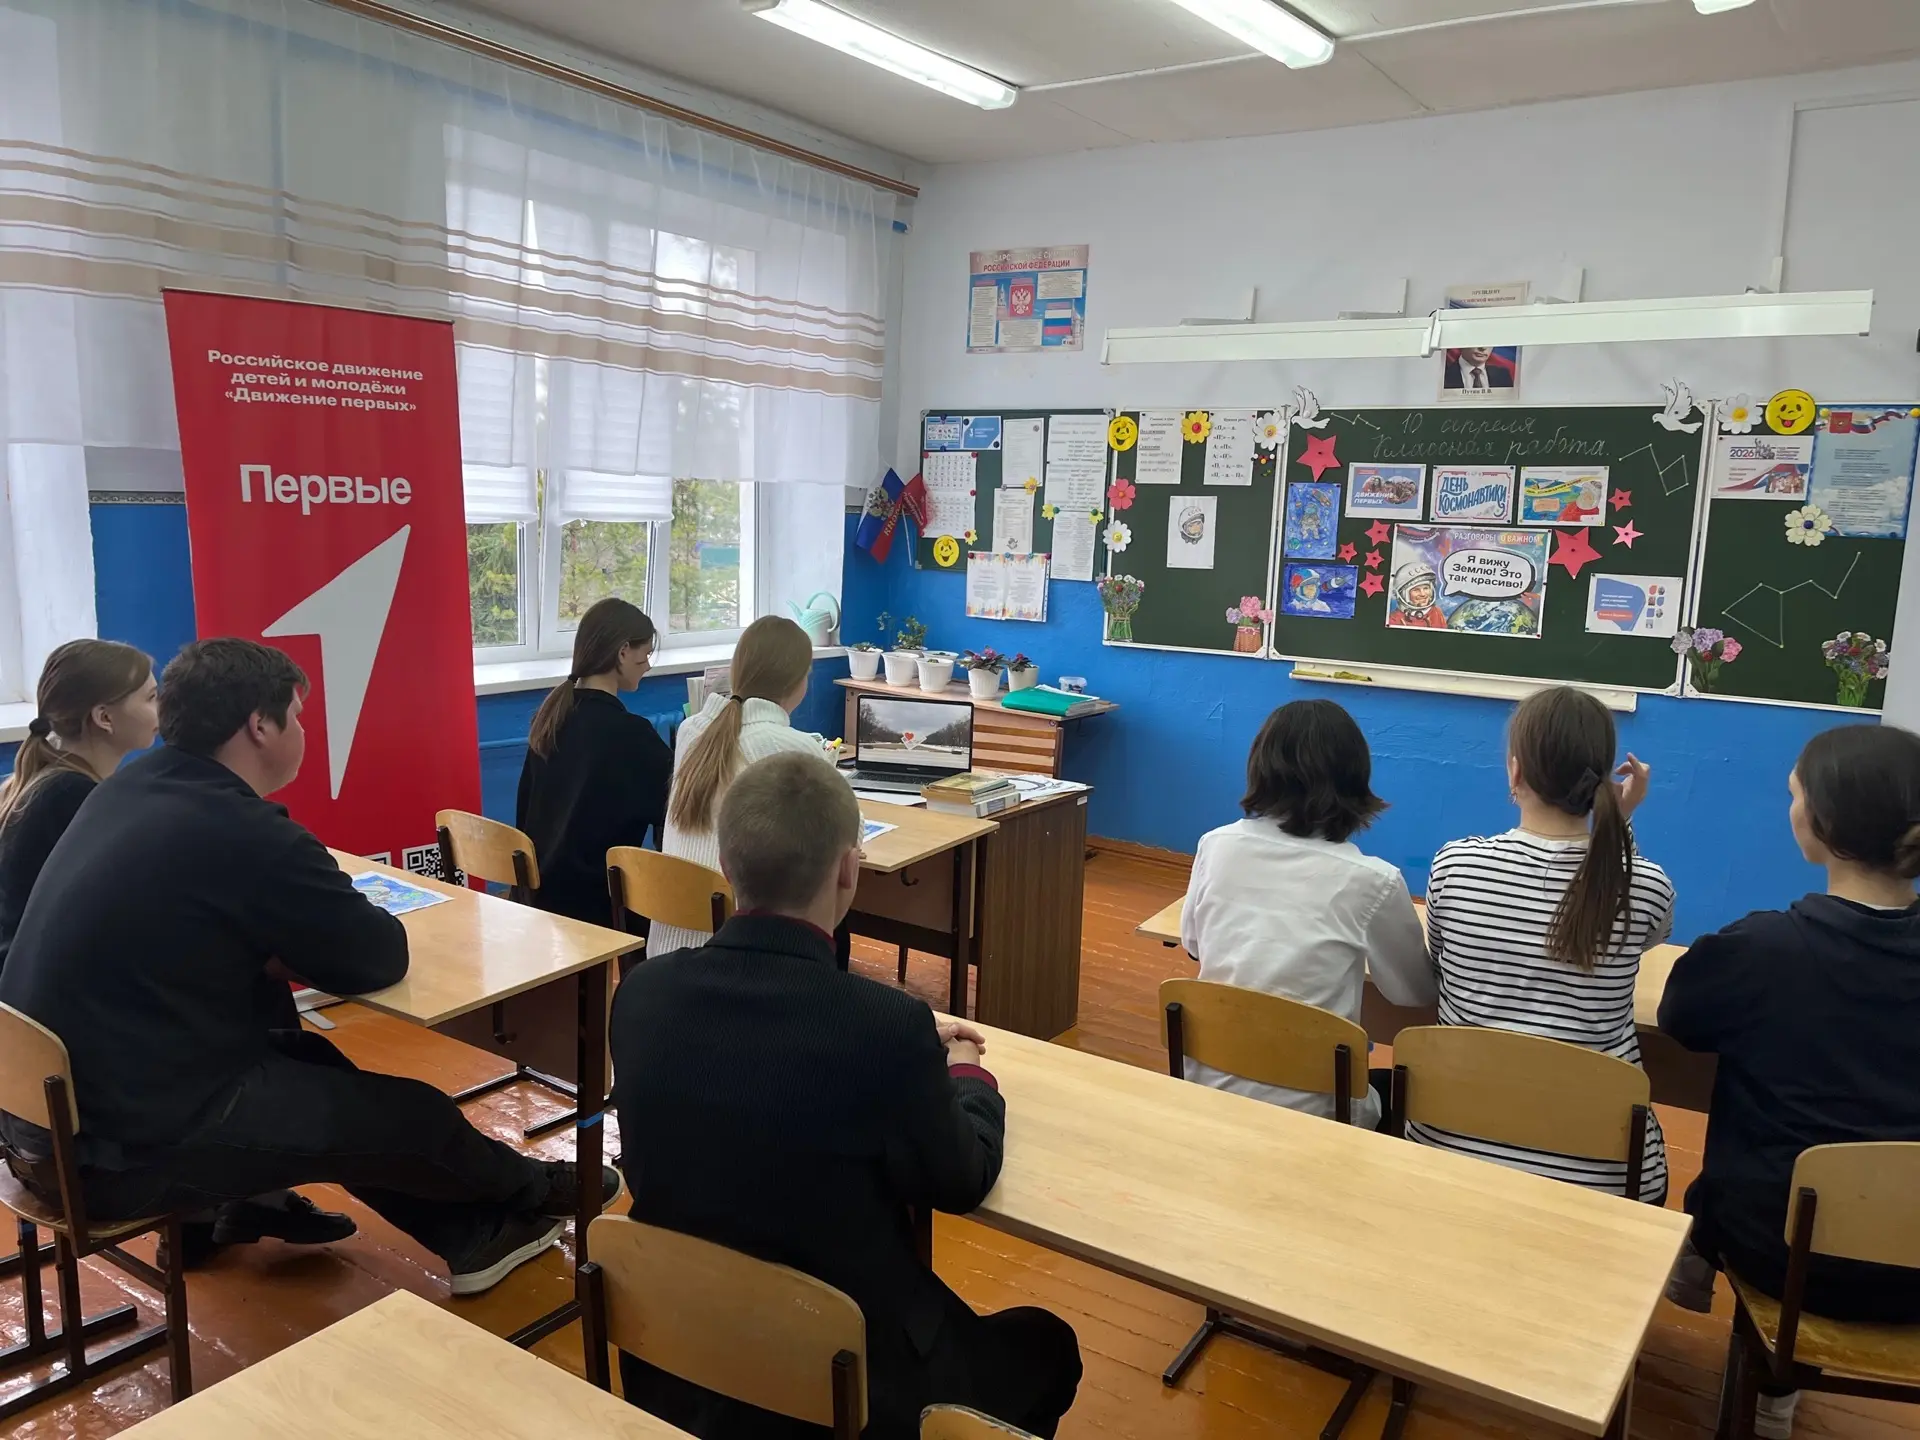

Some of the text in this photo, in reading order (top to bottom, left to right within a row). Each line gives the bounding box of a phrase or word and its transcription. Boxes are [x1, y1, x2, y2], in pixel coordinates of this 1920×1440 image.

[983, 259, 1070, 272] РОССИЙСКОЙ ФЕДЕРАЦИИ
[208, 349, 423, 381] Российское движение
[231, 372, 406, 395] детей и молодёжи
[225, 387, 417, 411] «Движение первых»
[1402, 412, 1536, 440] 10 апреля
[1730, 448, 1754, 458] 2026
[239, 463, 411, 516] Первые
[1354, 491, 1394, 499] ДВИЖЕНИЕ
[1440, 477, 1469, 496] ДЕНЬ
[1438, 484, 1507, 517] КОСМОНАВТИКИ
[1454, 532, 1496, 541] РАЗГОВОРЫ
[1507, 535, 1541, 543] ВАЖНОМ
[1467, 555, 1510, 569] Я вижу
[1452, 563, 1522, 579] Землю! Это
[1448, 573, 1523, 589] так красиво!
